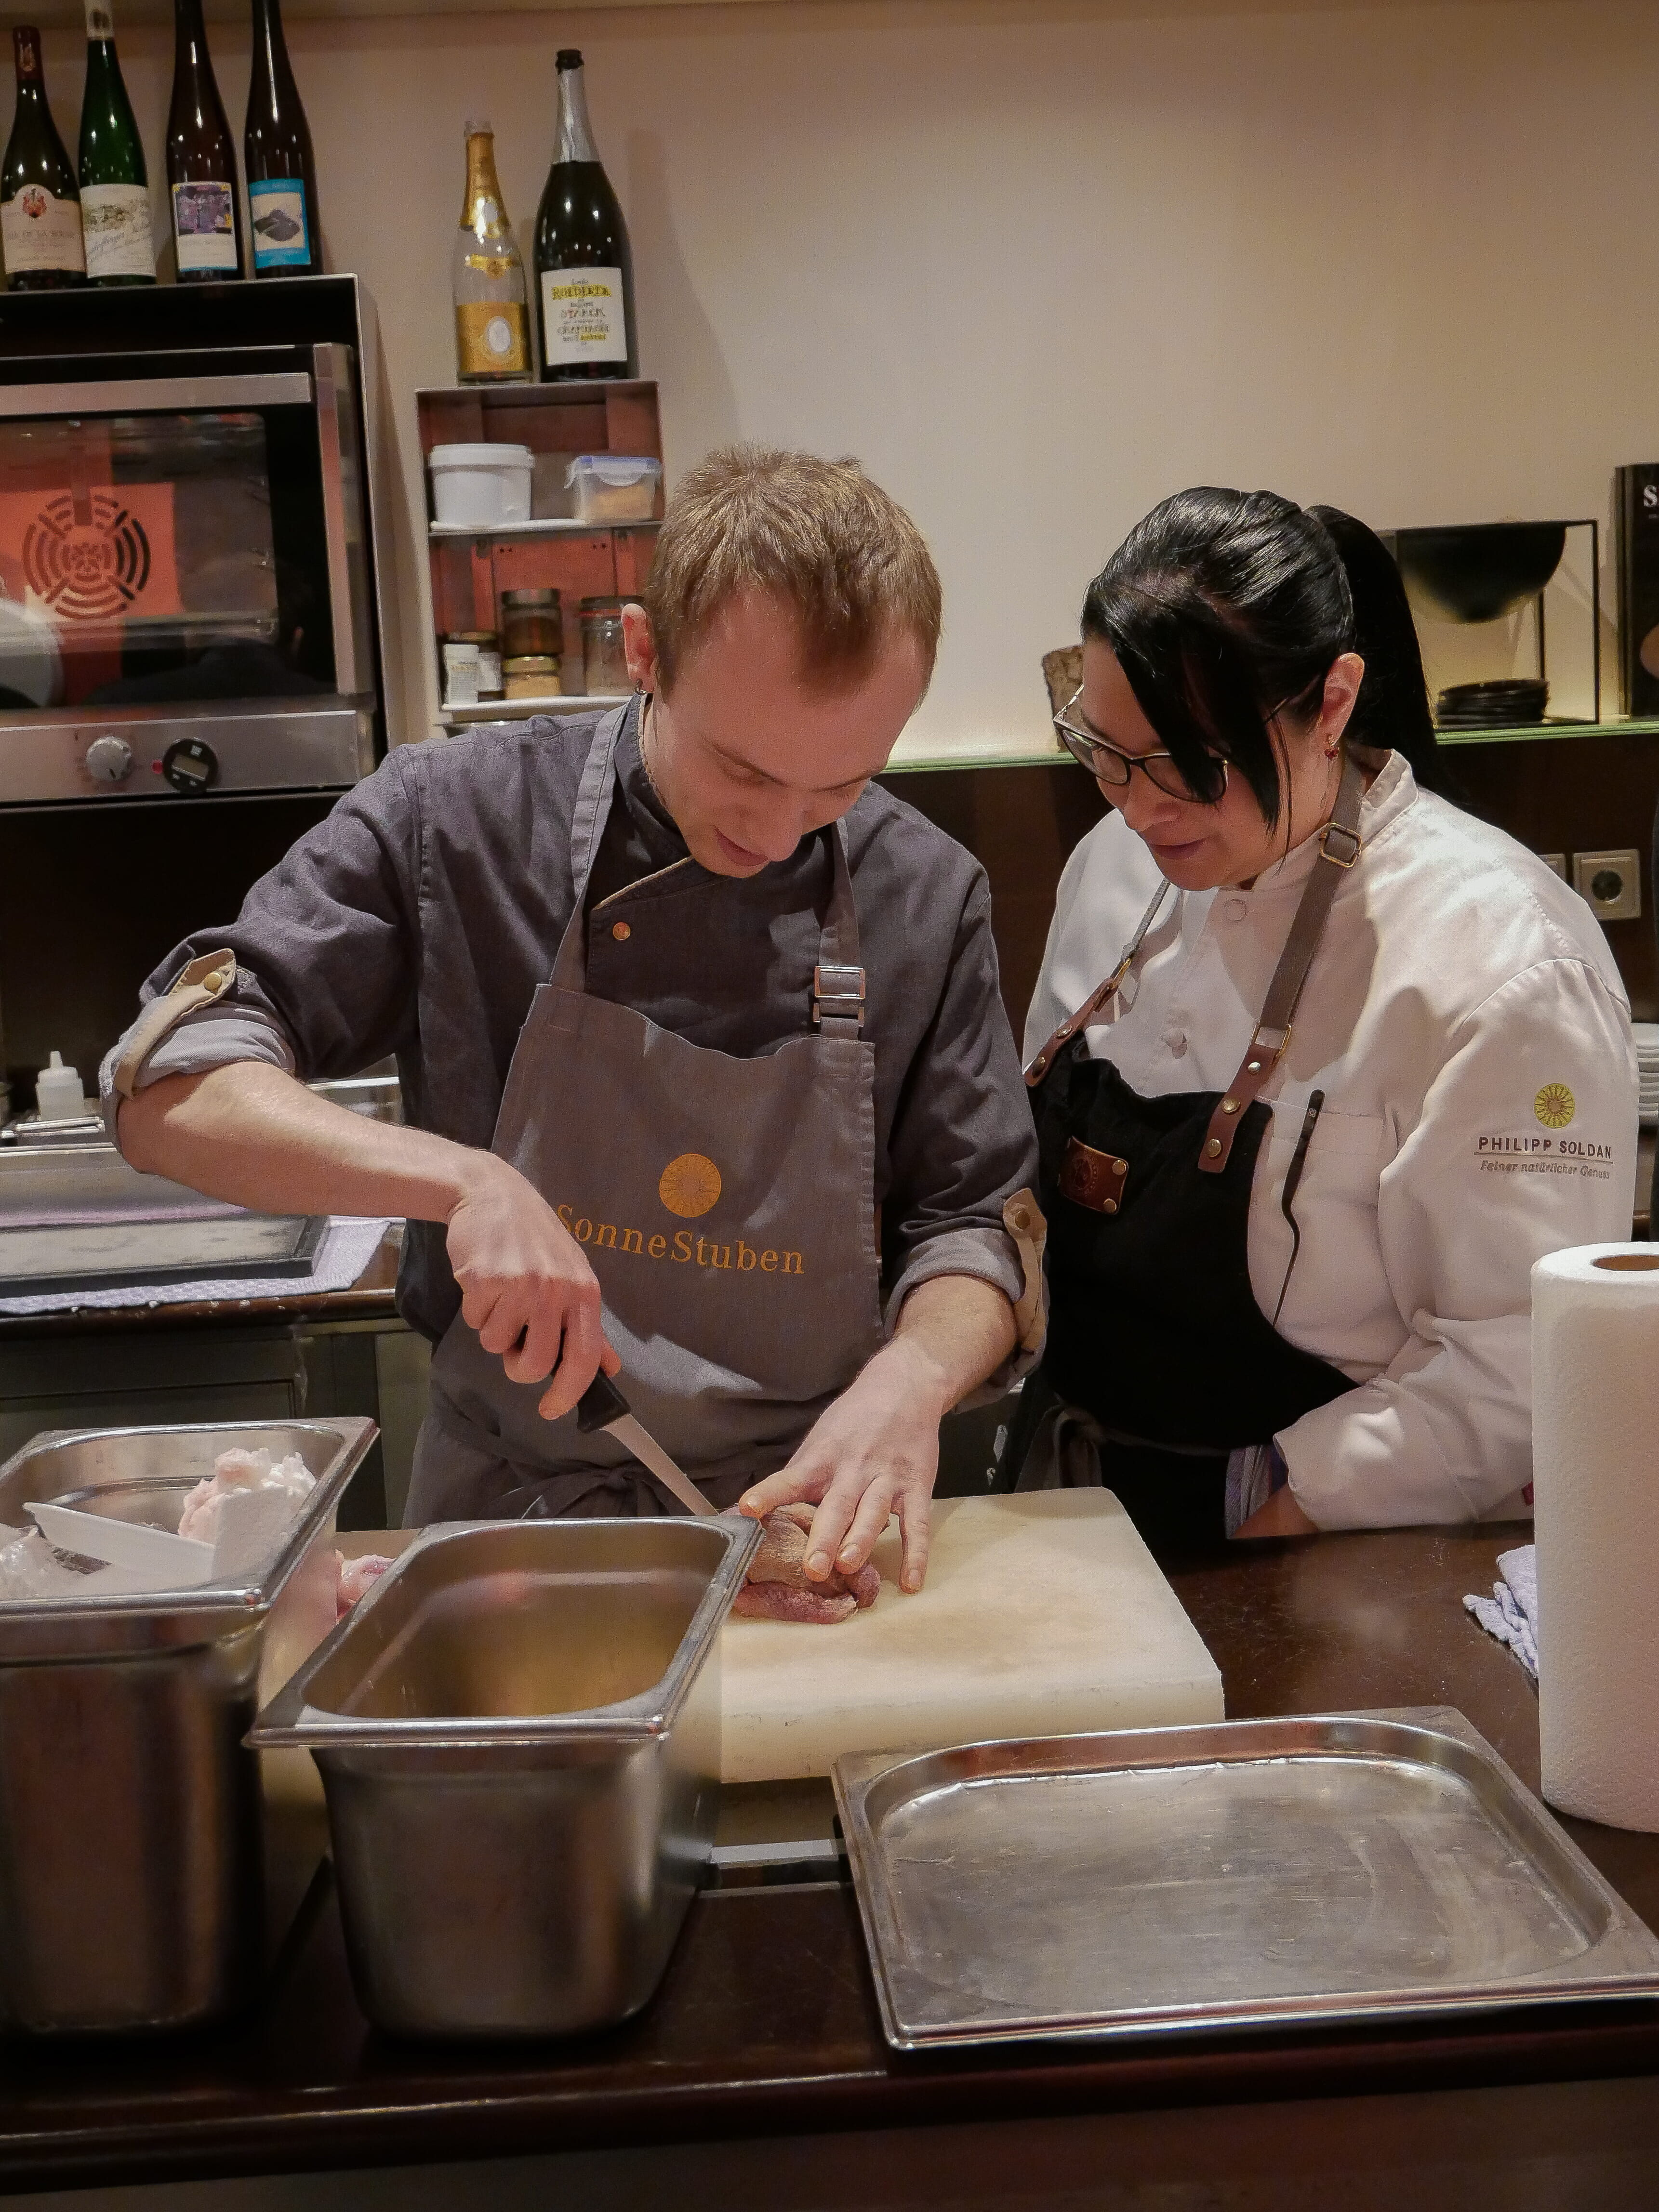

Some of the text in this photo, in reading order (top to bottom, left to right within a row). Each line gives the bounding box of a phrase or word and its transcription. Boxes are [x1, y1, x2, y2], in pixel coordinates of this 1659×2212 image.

[1644, 485, 1659, 508] S
[1478, 1137, 1612, 1159] PHILIPP SOLDAN
[1480, 1160, 1518, 1172] Feiner
[1580, 1164, 1611, 1180] Genuss
[557, 1204, 805, 1274] SonneStuben
